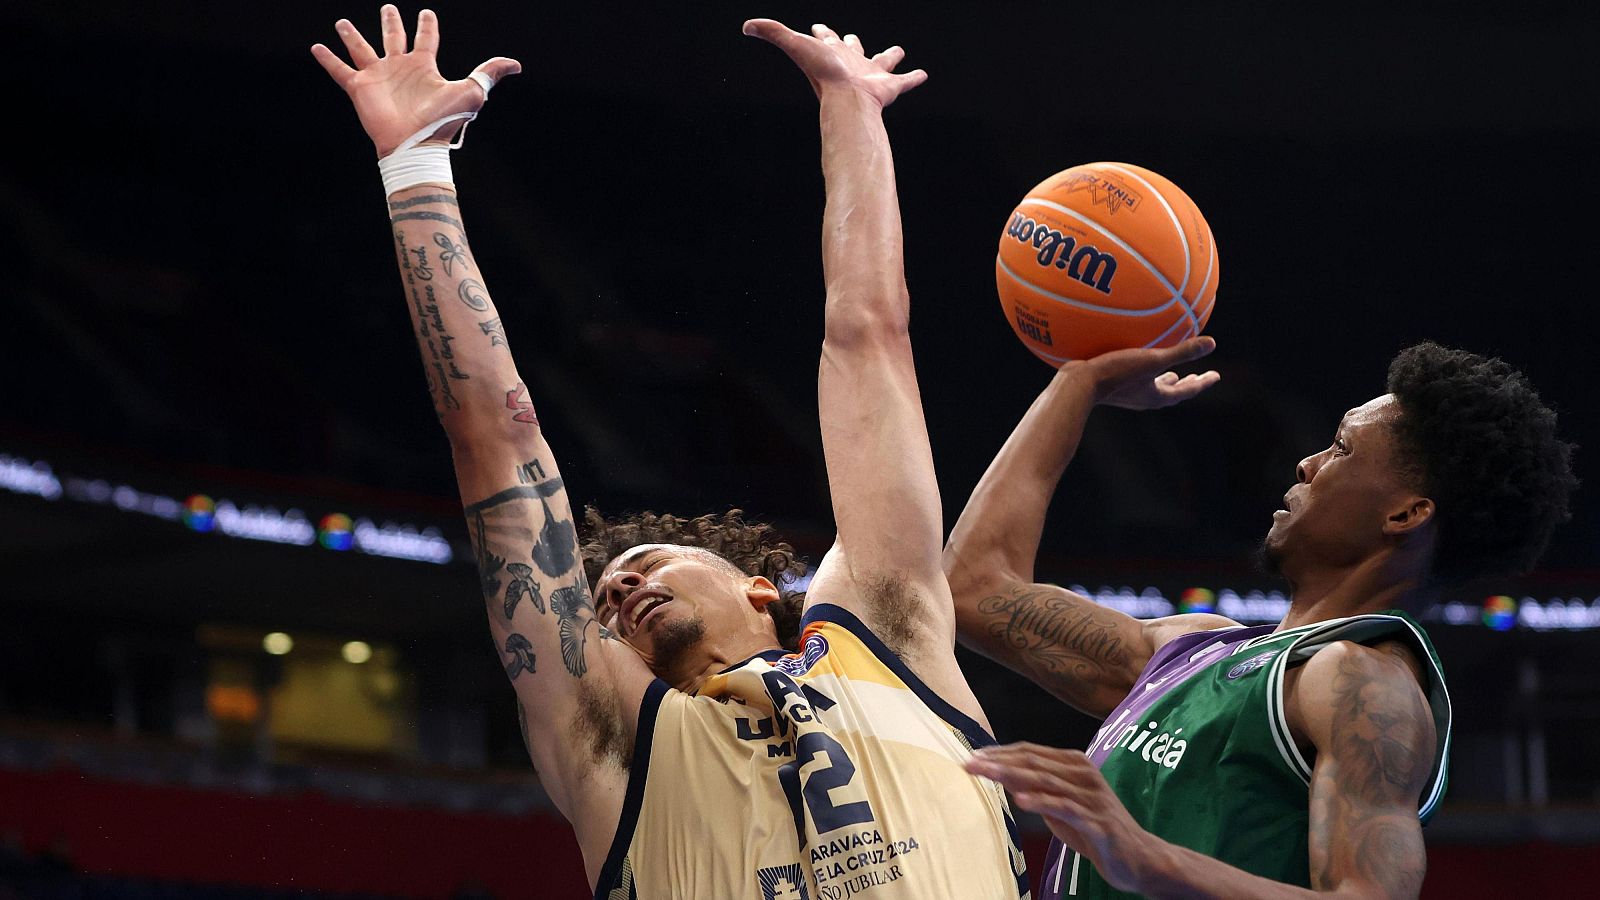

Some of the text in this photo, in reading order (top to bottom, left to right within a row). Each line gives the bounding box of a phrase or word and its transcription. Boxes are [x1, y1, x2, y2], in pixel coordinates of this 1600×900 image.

[1104, 181, 1137, 207] FINAL
[410, 246, 434, 282] God.
[1007, 209, 1118, 295] Wilson
[426, 304, 447, 333] shall
[437, 334, 456, 361] they
[810, 829, 884, 865] ARAVACA
[826, 862, 846, 880] LA
[846, 849, 887, 871] CRUZ
[843, 864, 904, 900] JUBILAR
